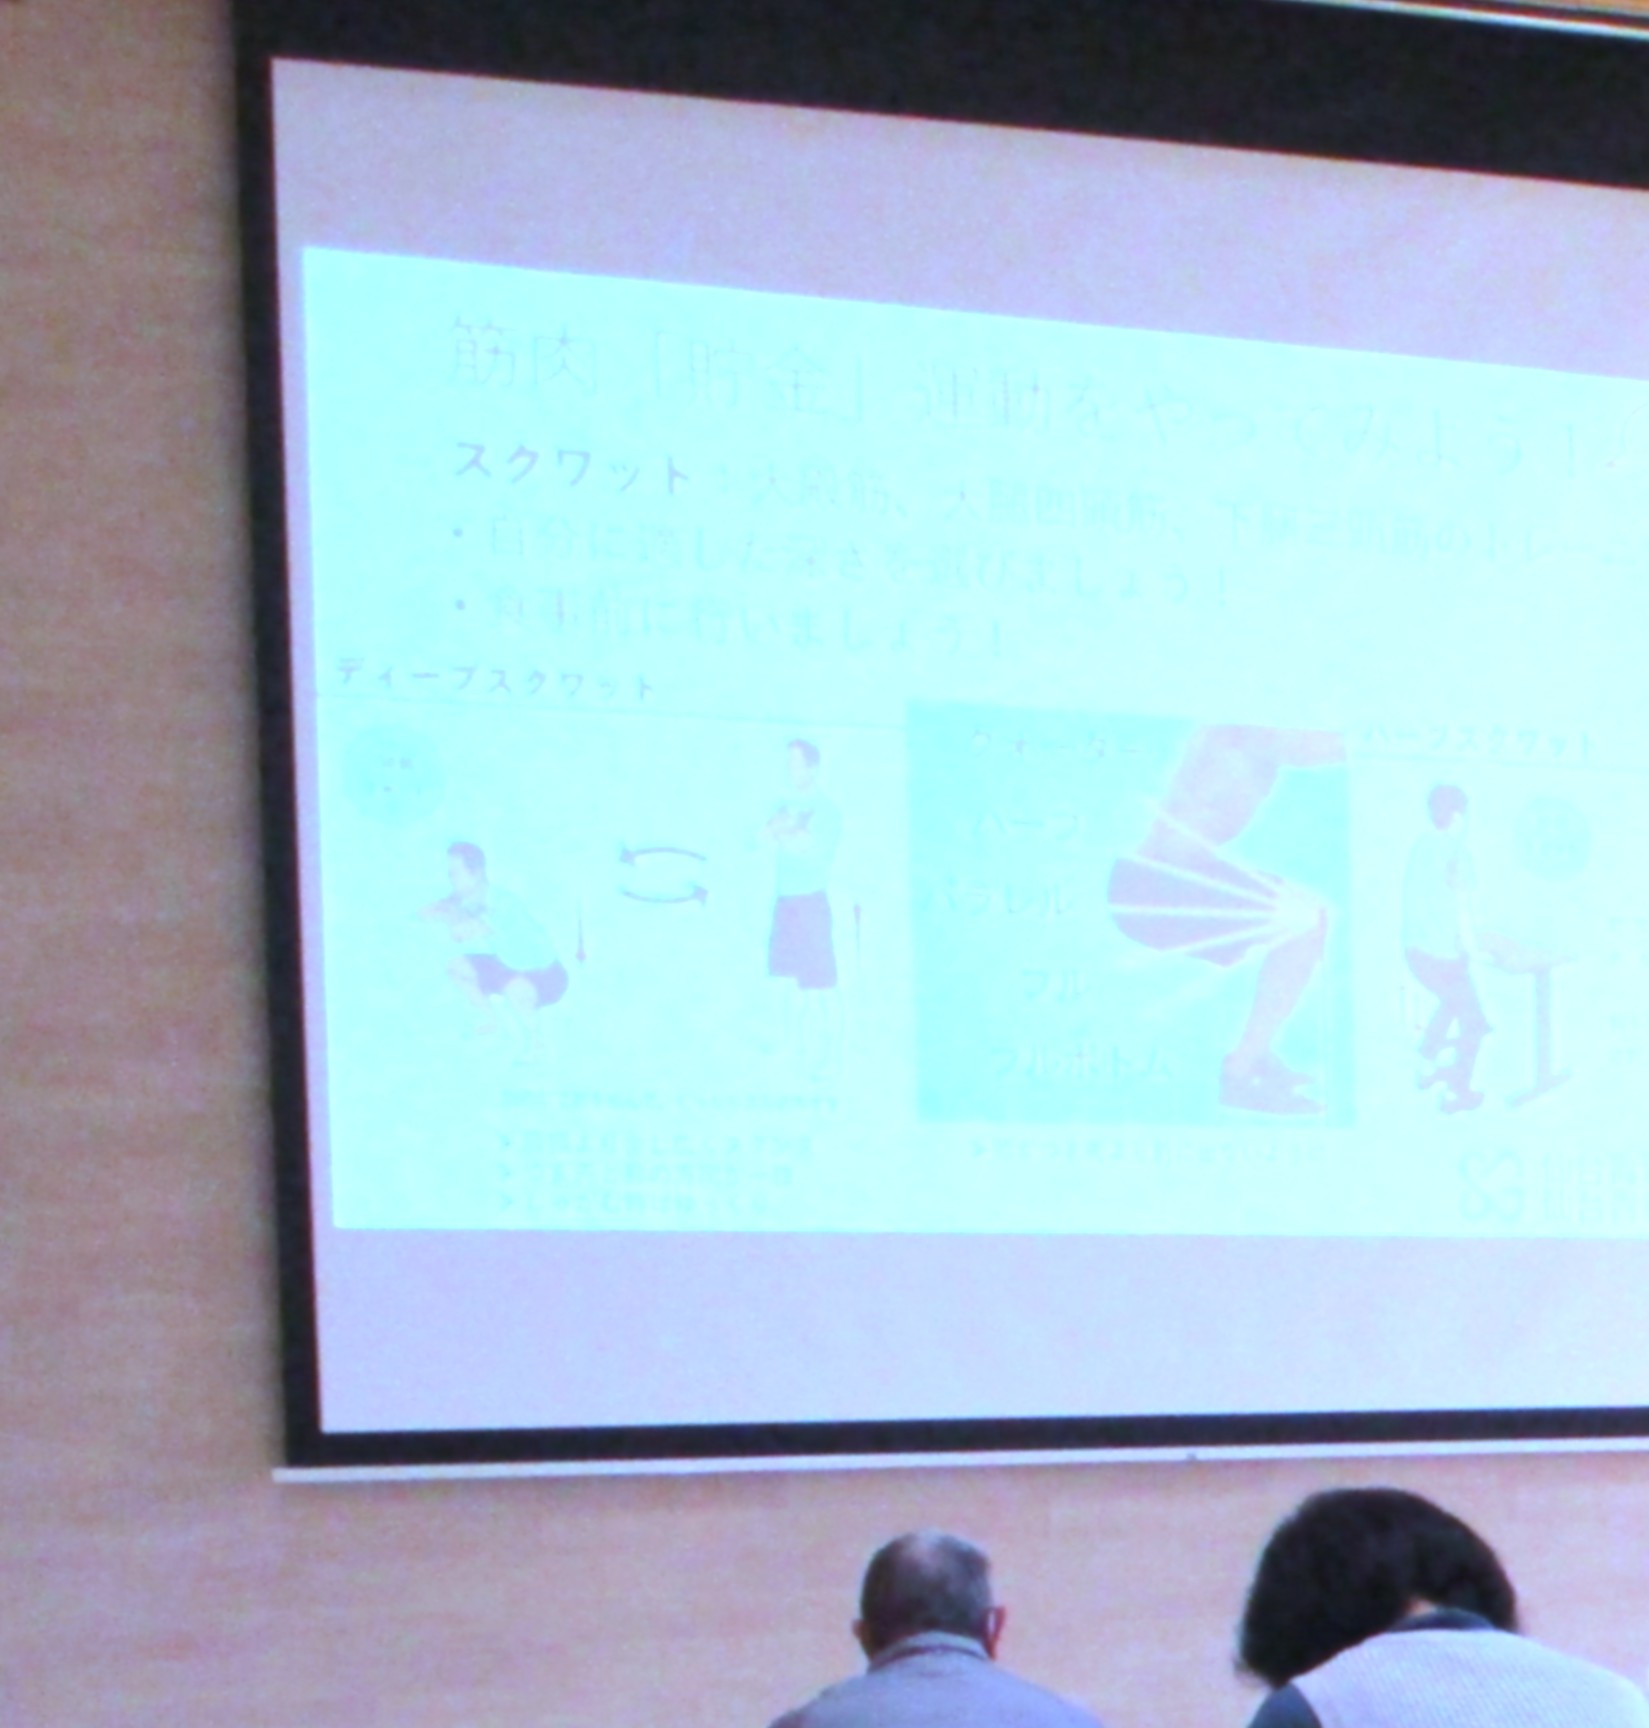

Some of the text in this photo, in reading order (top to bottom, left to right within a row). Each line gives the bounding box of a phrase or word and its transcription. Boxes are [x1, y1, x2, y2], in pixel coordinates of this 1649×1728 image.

[453, 440, 690, 495] スクワット
